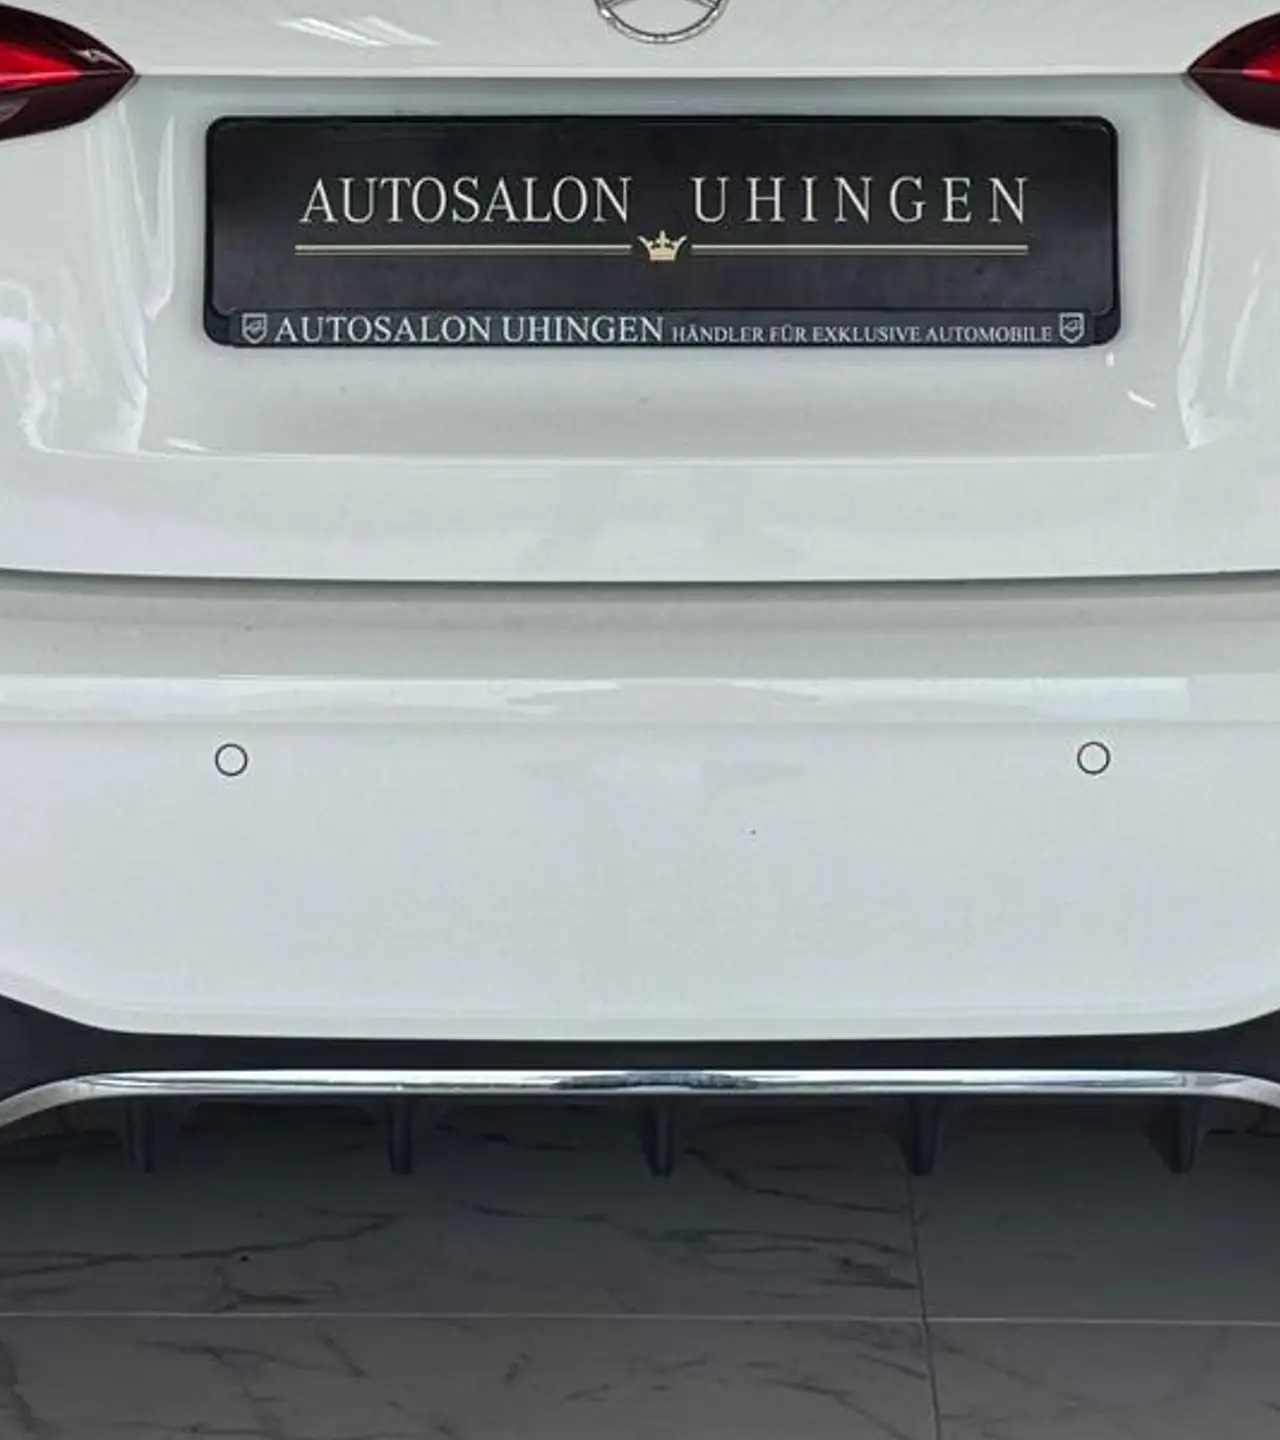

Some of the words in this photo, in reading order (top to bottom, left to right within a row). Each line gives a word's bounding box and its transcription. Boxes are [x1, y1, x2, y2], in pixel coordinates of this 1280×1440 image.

[298, 176, 632, 224] AUTOSALON
[691, 176, 1027, 224] UHINGEN
[273, 315, 490, 344] AUTOSALON
[502, 315, 664, 344] UHINGEN
[672, 324, 764, 343] HÄNDLER
[769, 323, 807, 343] FÜR
[812, 326, 921, 343] EXKLUSIVE
[925, 326, 1053, 343] AUTOMOBILE
